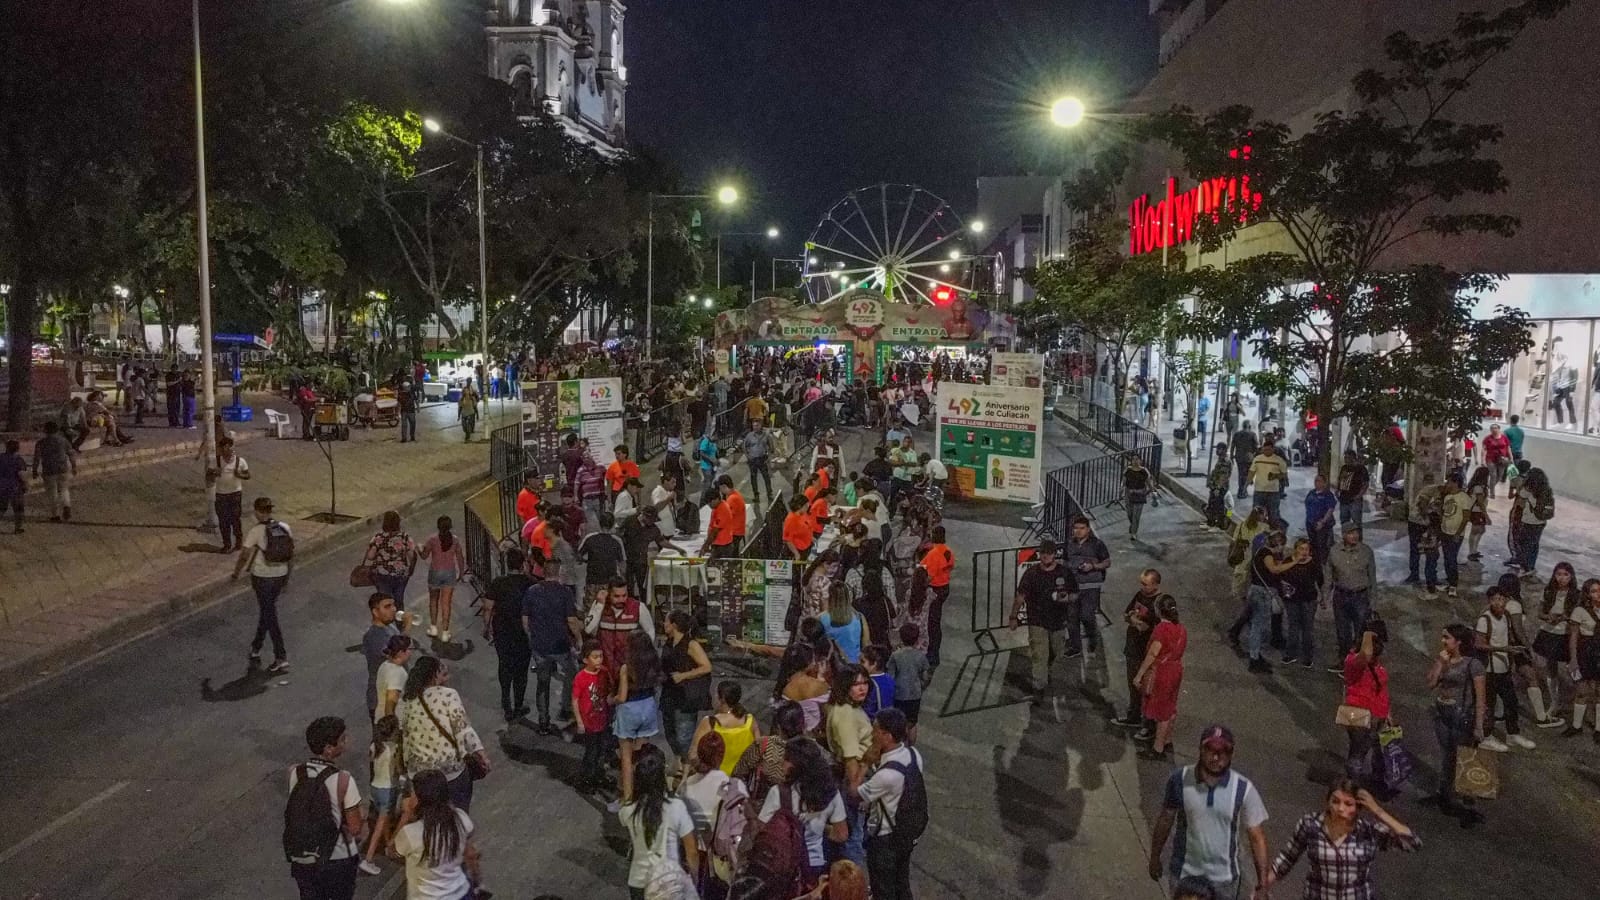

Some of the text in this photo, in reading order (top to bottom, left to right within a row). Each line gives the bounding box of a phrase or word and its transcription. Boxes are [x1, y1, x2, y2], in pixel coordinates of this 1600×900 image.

[852, 301, 877, 314] 492
[783, 326, 838, 335] ENTRADA
[892, 327, 948, 337] ENTRADA
[590, 386, 612, 399] 492
[948, 397, 1030, 416] 492 Aniversario
[770, 560, 788, 569] 492
